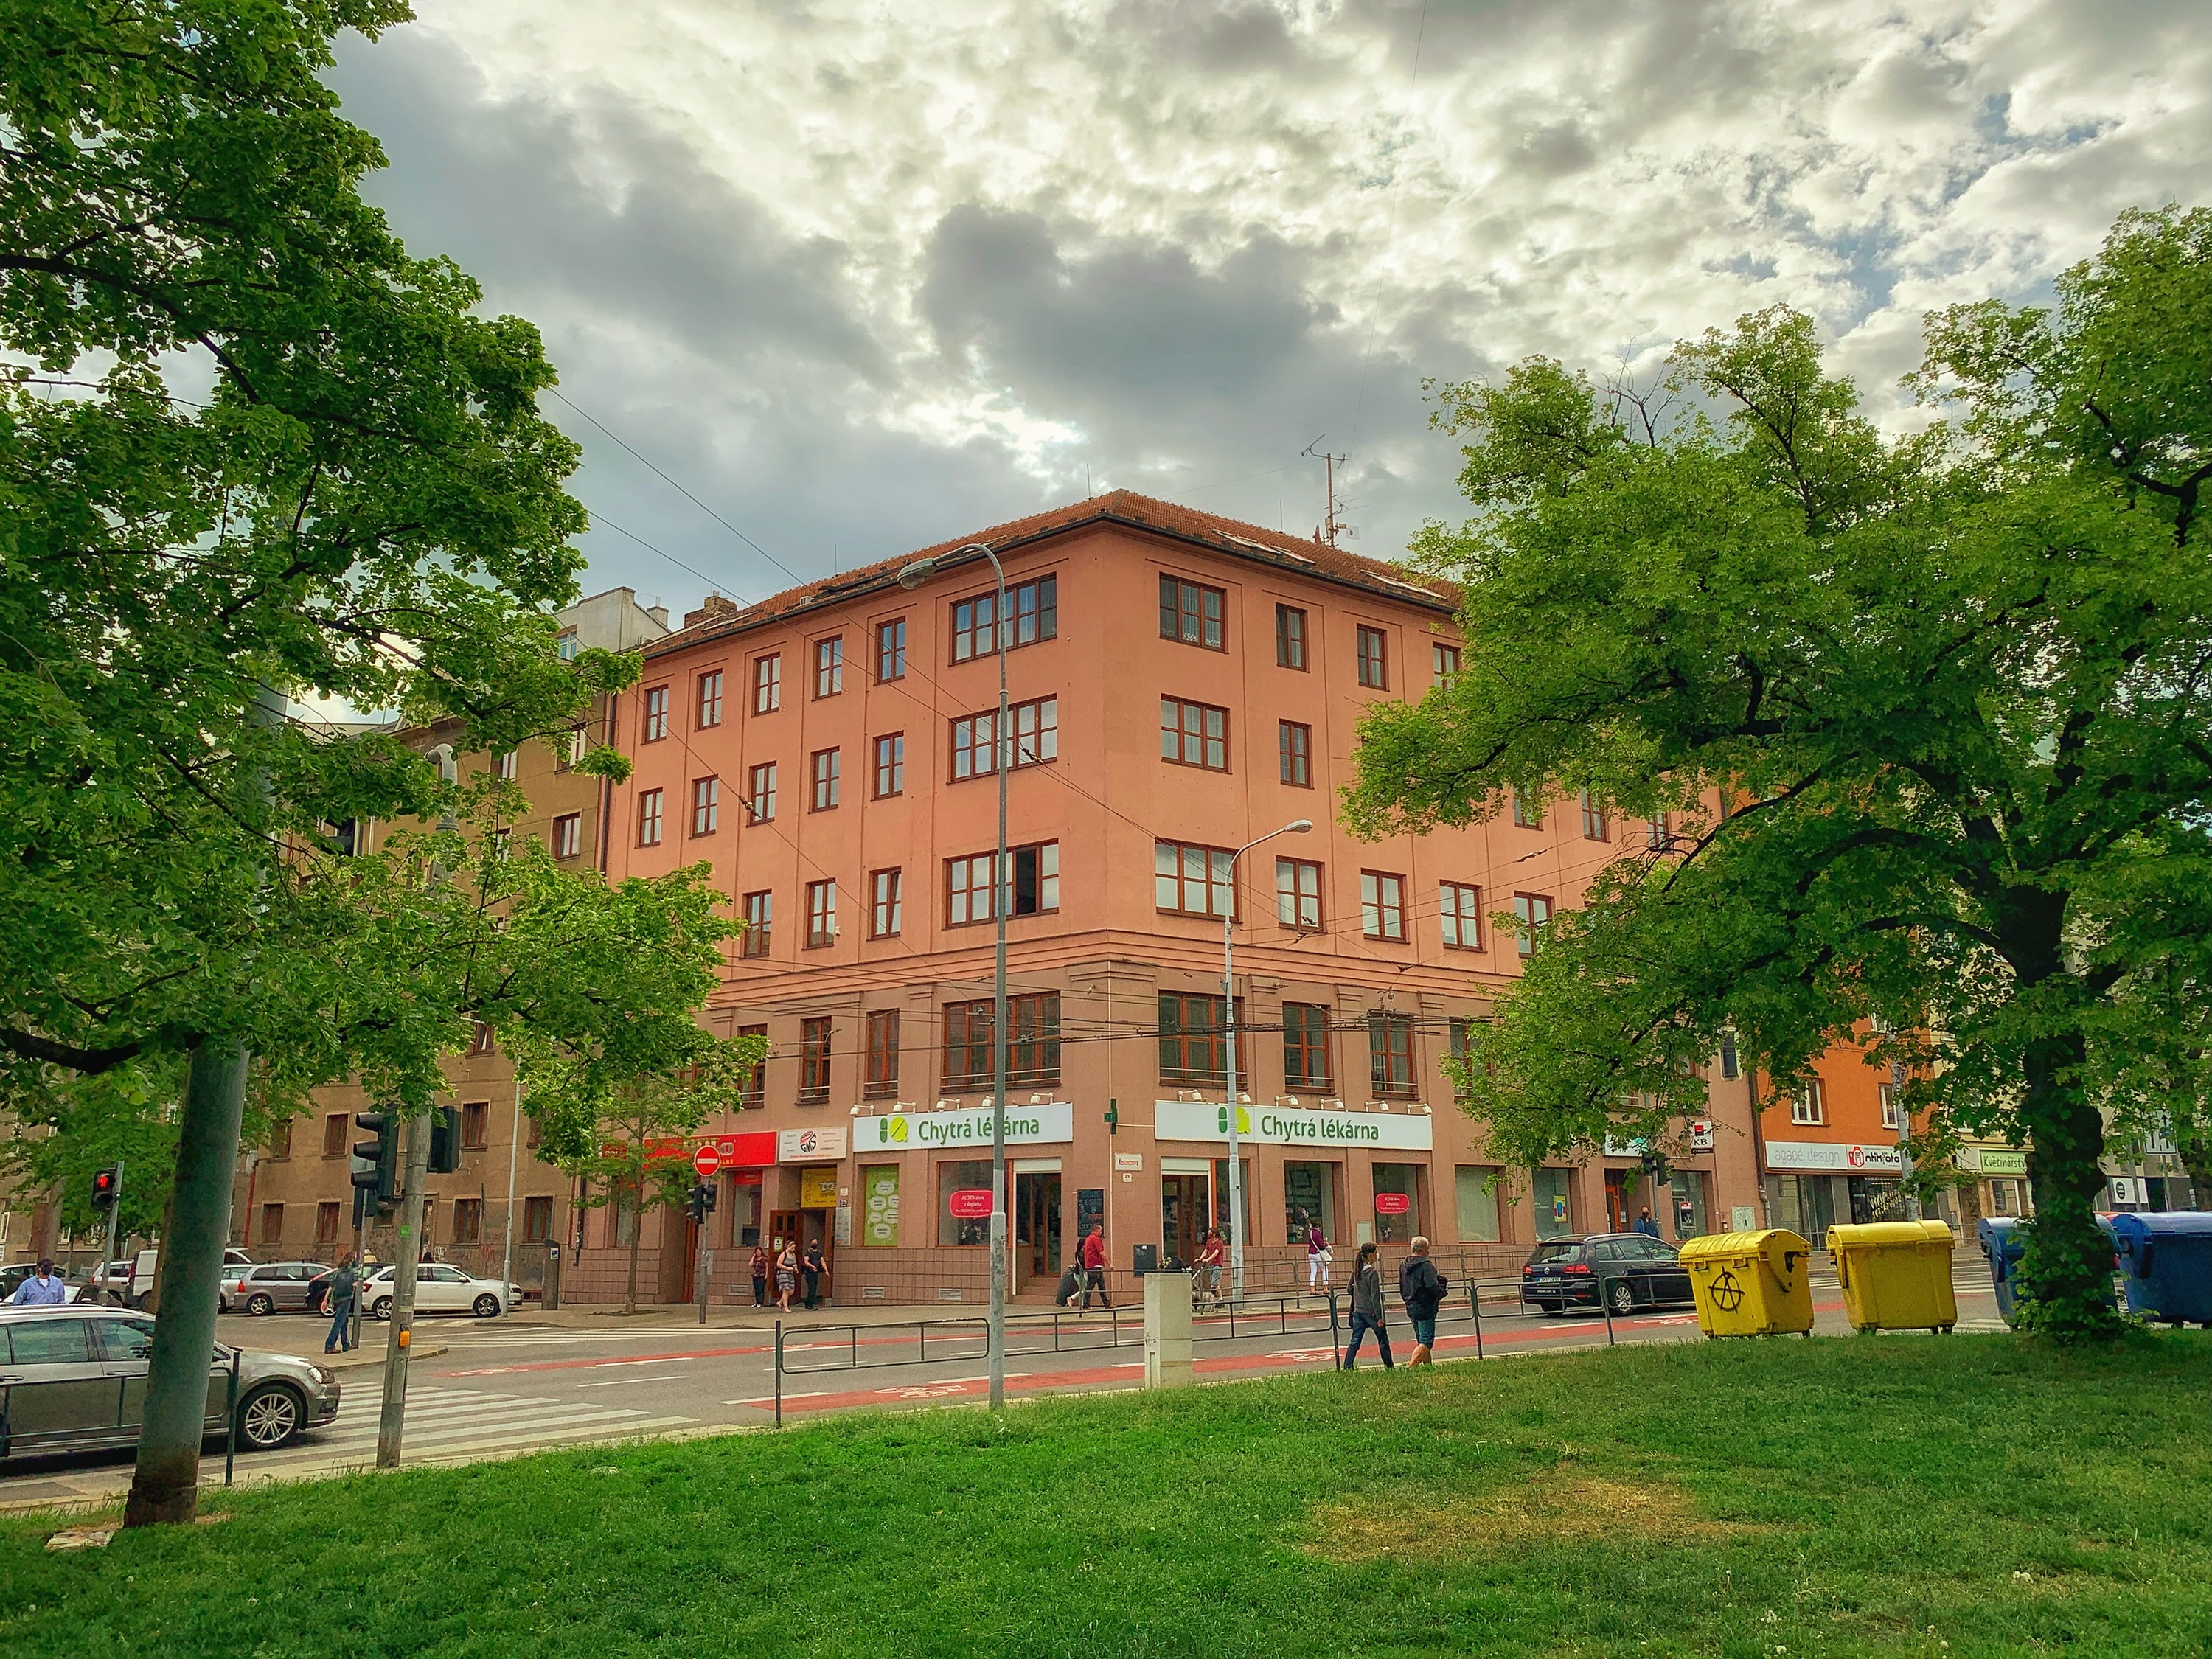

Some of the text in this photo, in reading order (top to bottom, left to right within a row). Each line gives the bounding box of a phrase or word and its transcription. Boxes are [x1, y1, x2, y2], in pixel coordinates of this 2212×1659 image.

[919, 1118, 971, 1145] Chytrá
[977, 1116, 1040, 1137] léárna
[1261, 1115, 1316, 1141] Chytrá
[1321, 1118, 1379, 1140] lékárna
[1775, 1147, 1840, 1166] agapé design
[1983, 1155, 2026, 1169] Květinářstv
